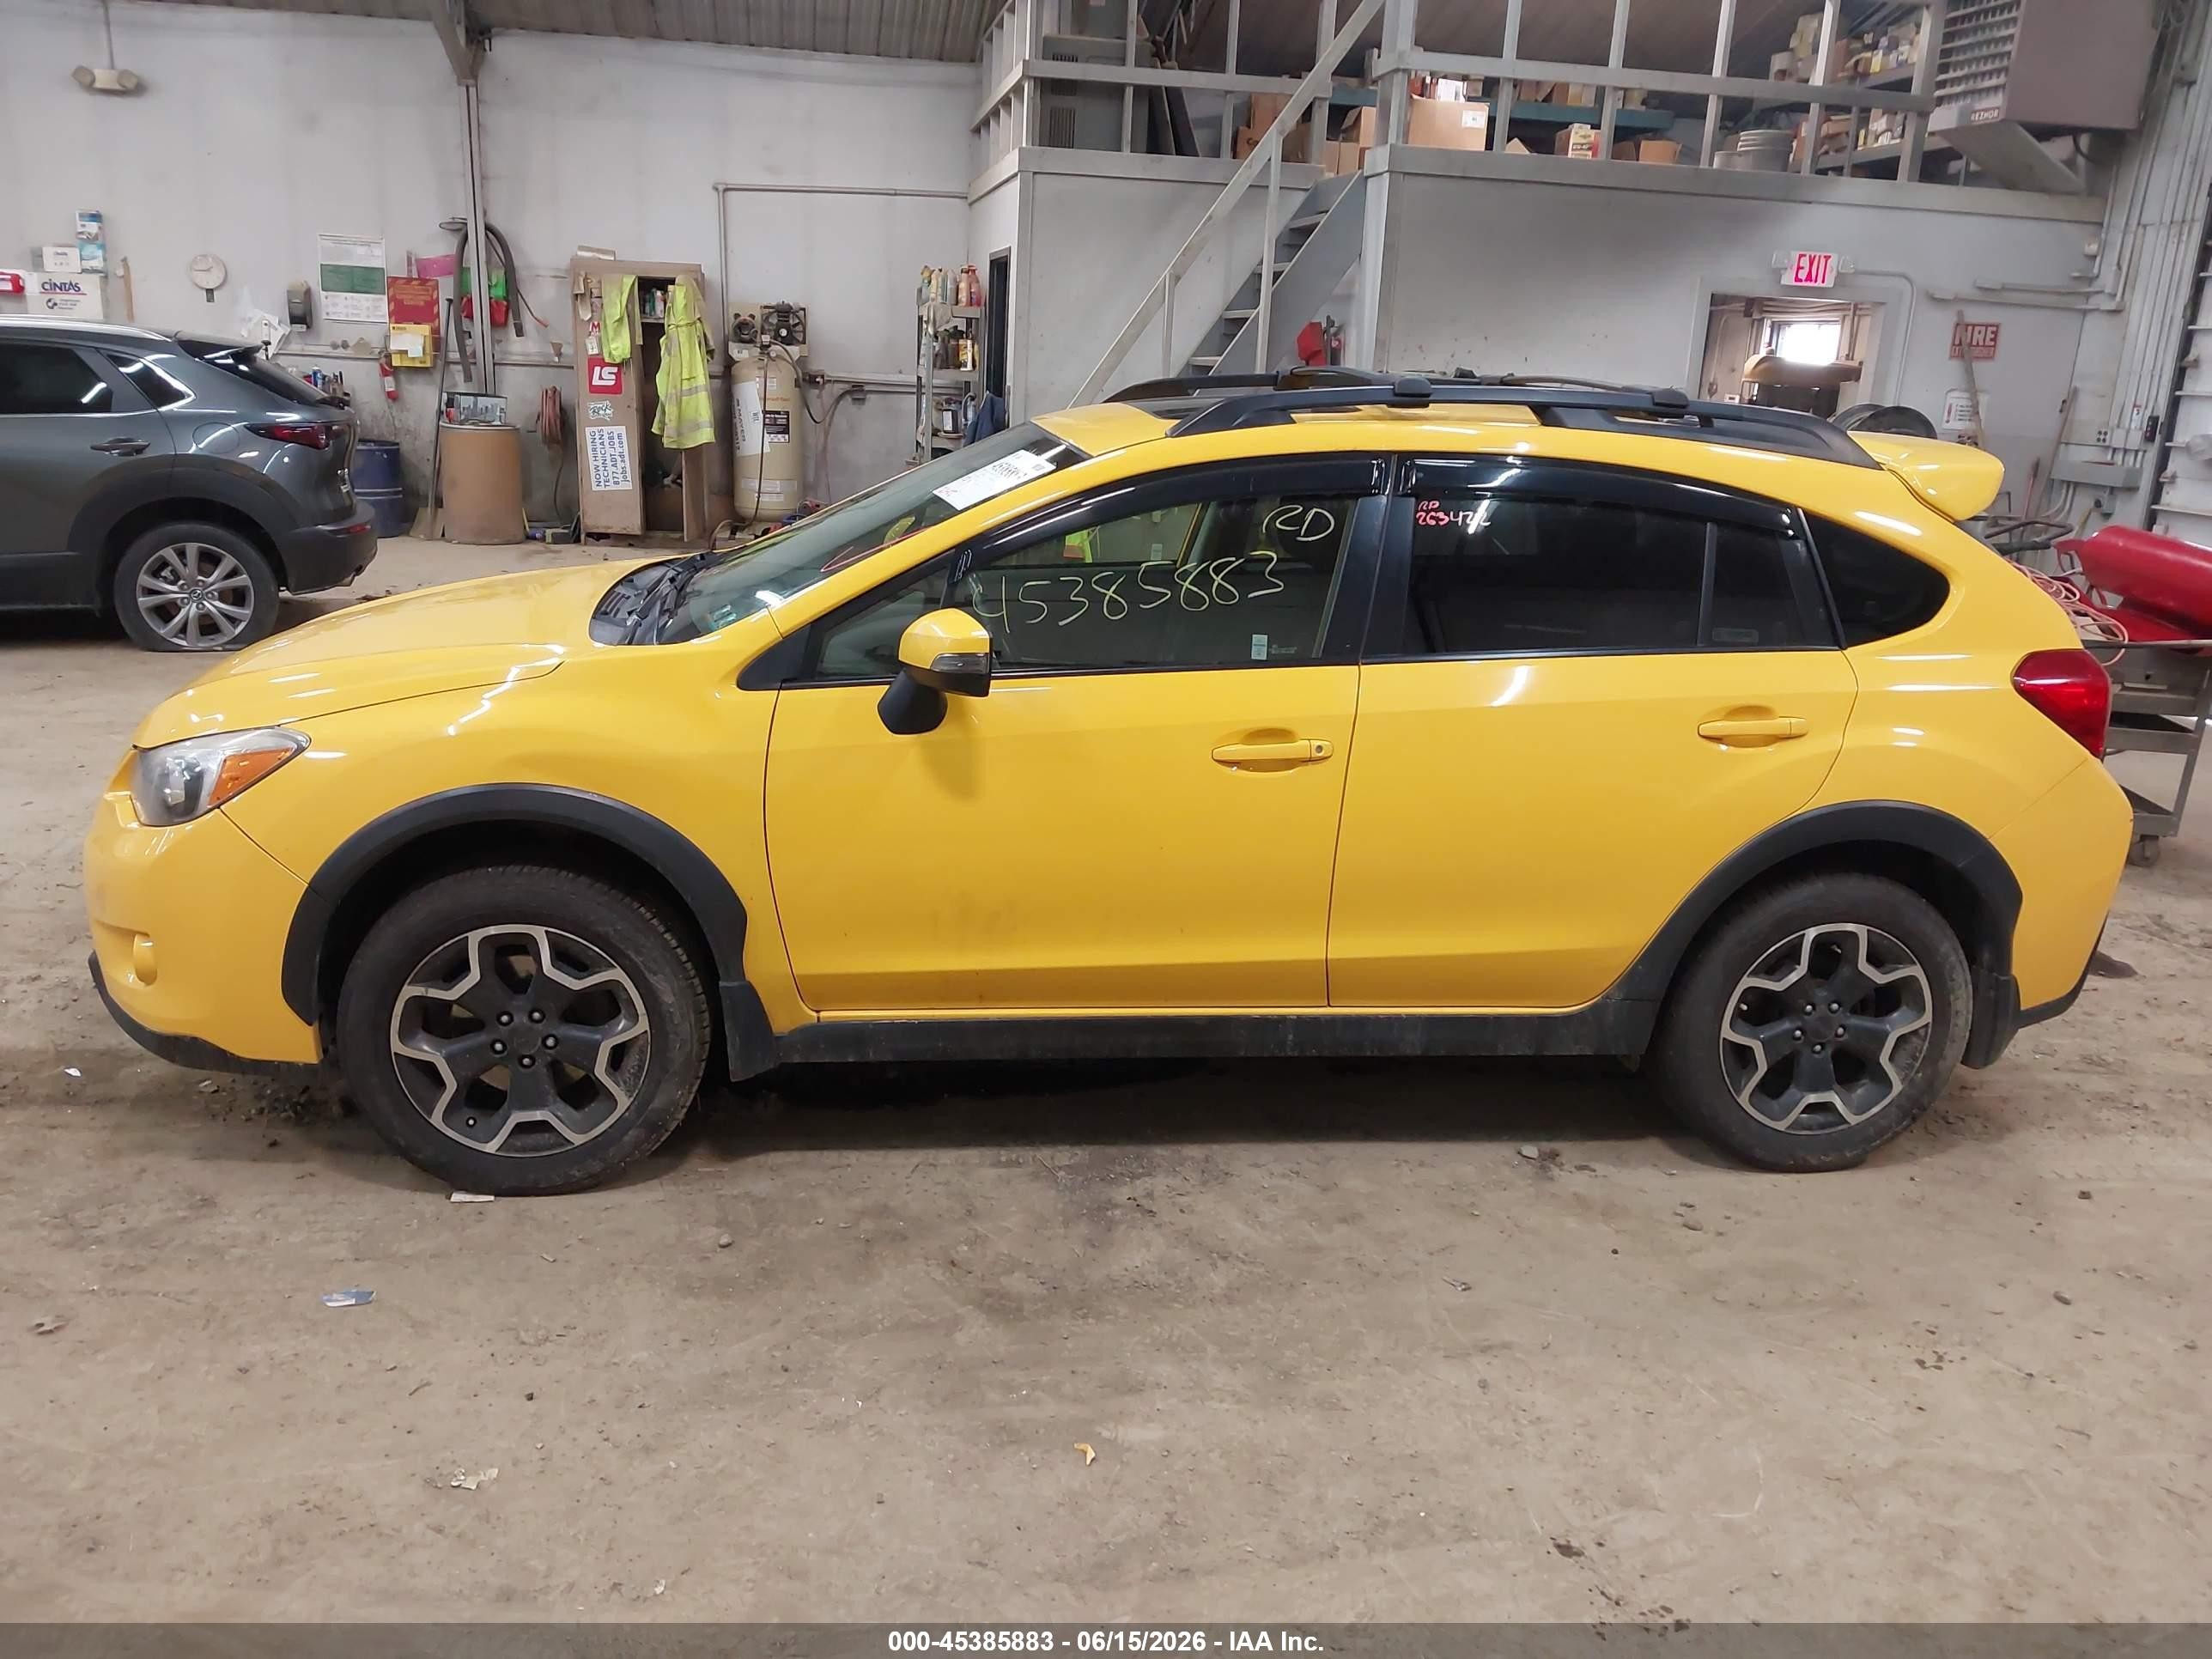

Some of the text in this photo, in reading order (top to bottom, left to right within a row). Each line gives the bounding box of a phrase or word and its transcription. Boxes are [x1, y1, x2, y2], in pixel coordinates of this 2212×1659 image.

[41, 278, 82, 292] CINTAS
[1794, 253, 1832, 284] EXIT
[592, 366, 619, 386] LS
[589, 430, 603, 488] NOW HIRING
[598, 428, 611, 489] TECHNICIANS
[972, 550, 1285, 634] 45385883
